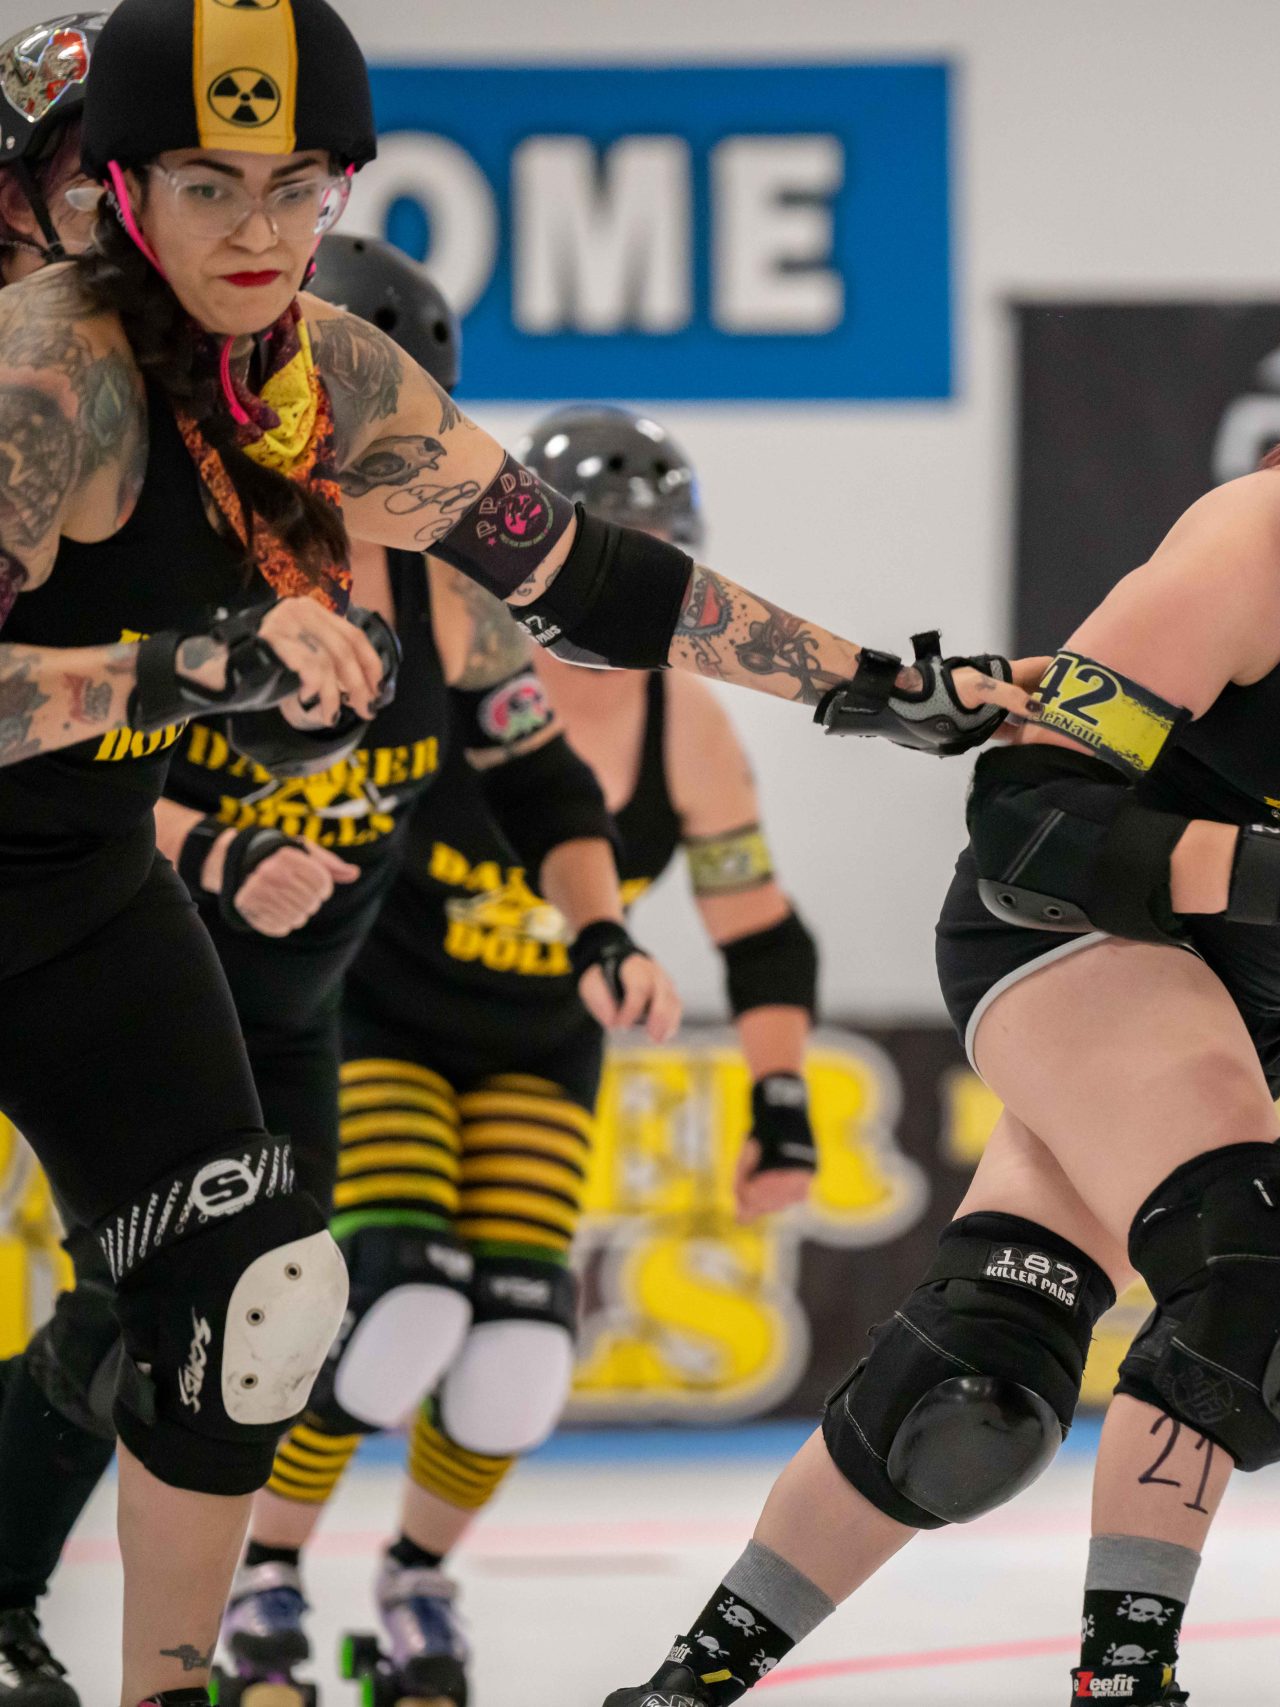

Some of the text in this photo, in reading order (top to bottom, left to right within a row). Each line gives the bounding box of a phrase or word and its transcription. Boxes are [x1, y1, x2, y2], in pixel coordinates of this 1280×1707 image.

[1036, 654, 1119, 727] 42
[986, 1265, 1076, 1307] KILLER PADS
[996, 1248, 1079, 1285] 187
[1137, 1412, 1215, 1515] 21
